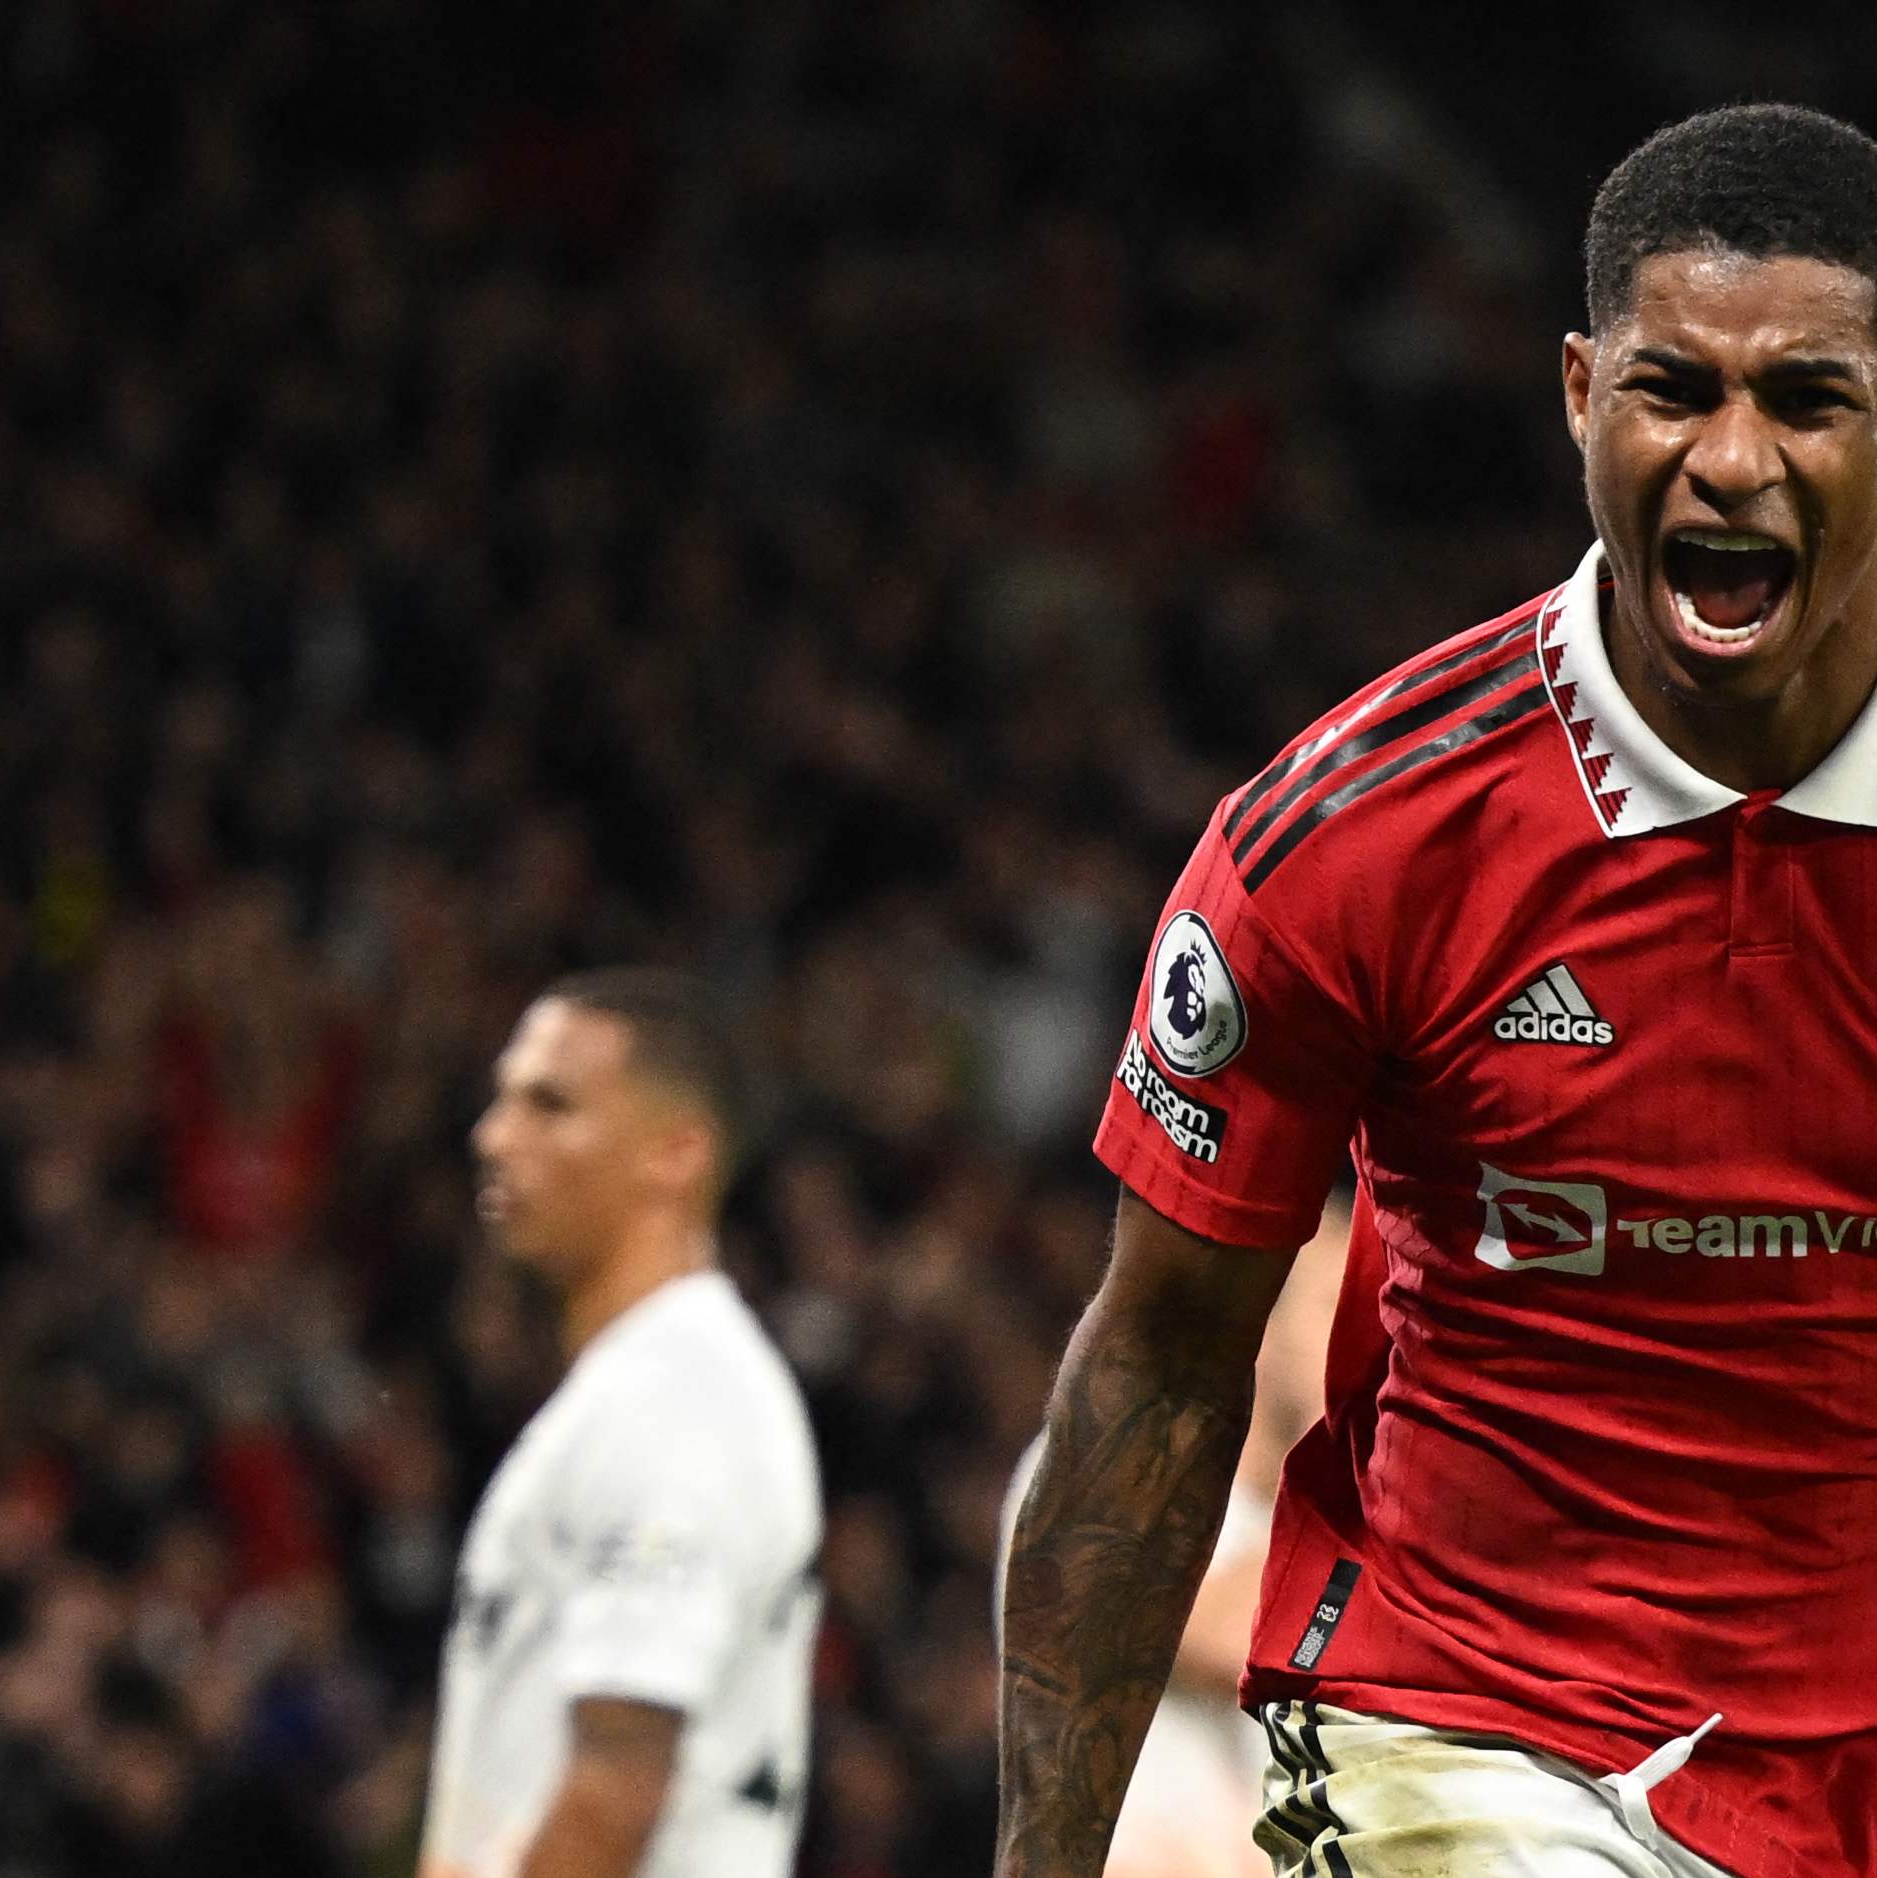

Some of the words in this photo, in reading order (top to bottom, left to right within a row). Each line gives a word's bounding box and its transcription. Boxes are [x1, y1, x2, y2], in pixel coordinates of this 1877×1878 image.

[1166, 1036, 1199, 1061] Premier
[1200, 1018, 1228, 1057] League
[1494, 1011, 1613, 1044] adidas
[1116, 1053, 1142, 1099] For
[1140, 1087, 1218, 1164] racism
[1125, 1027, 1147, 1078] No
[1146, 1066, 1209, 1134] room
